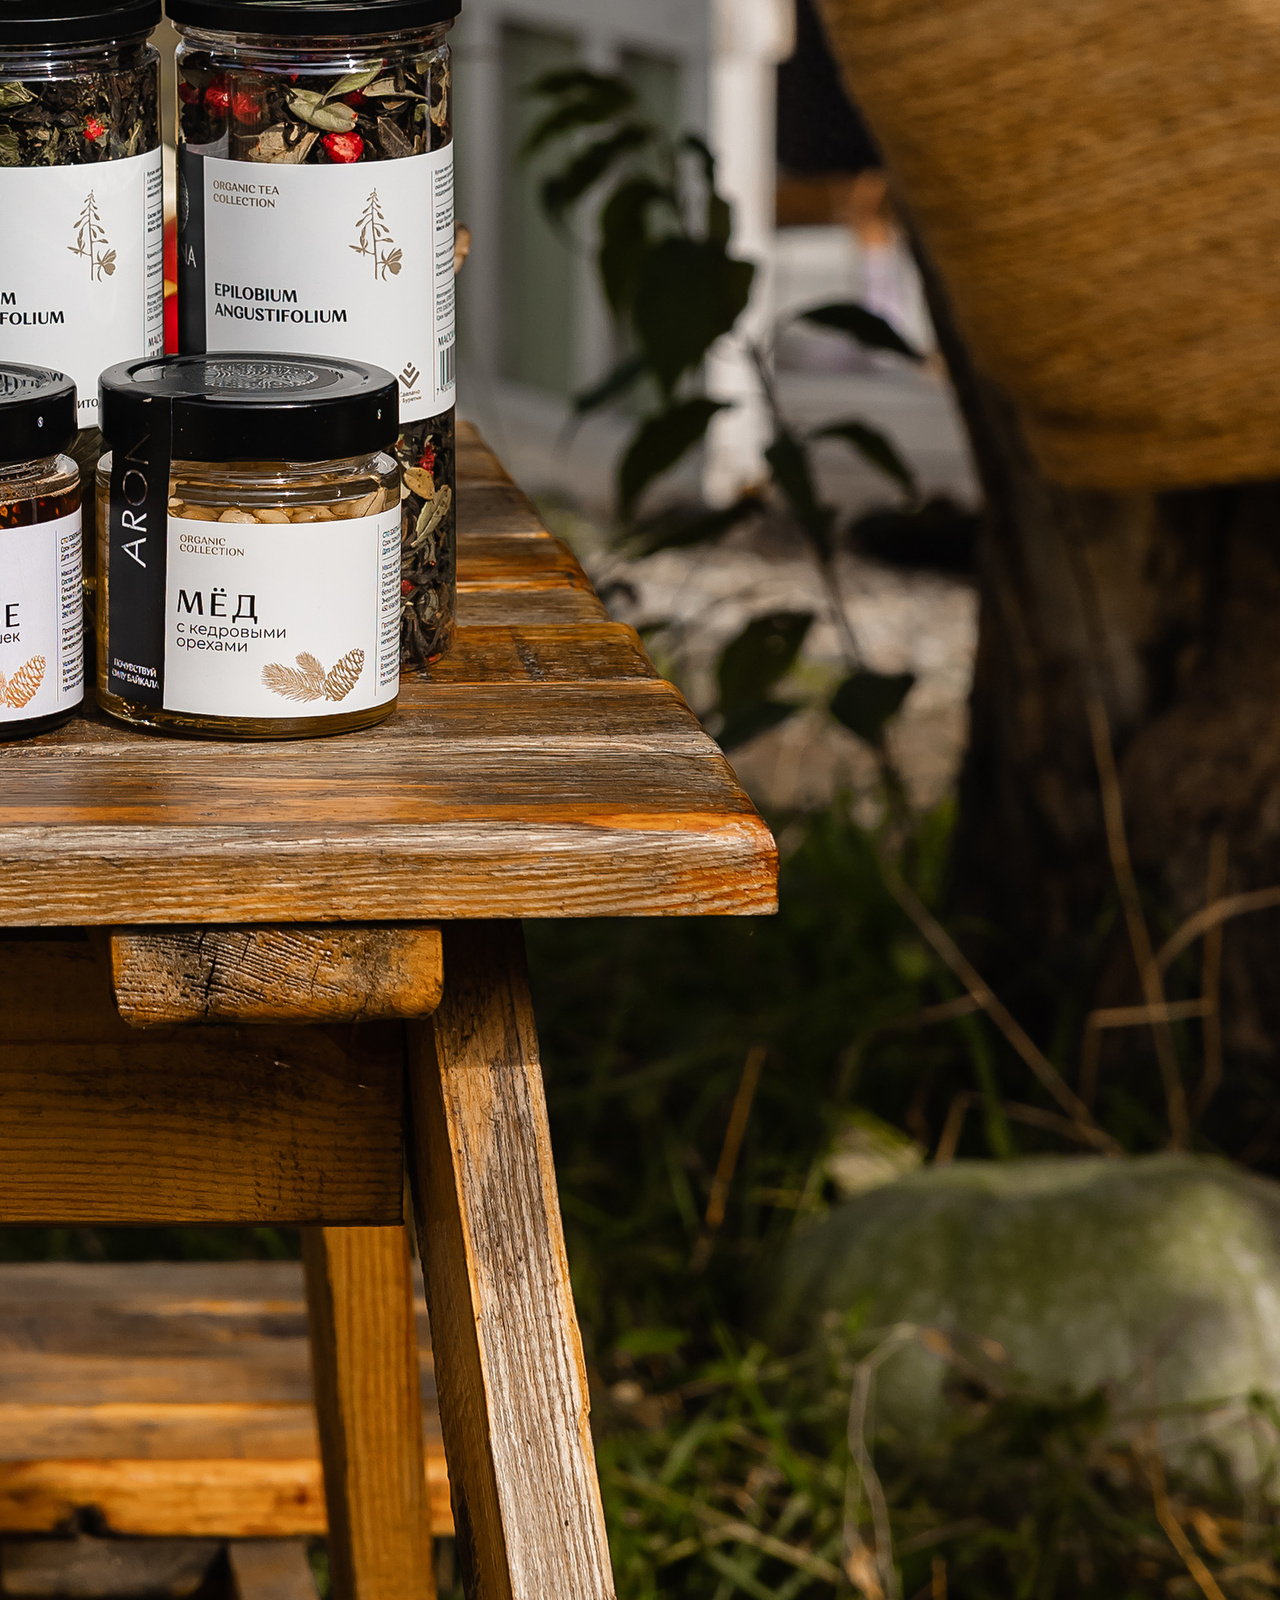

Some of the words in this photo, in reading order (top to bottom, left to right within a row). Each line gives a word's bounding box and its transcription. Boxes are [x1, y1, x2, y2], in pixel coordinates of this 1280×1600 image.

[213, 180, 255, 195] ORGANIC
[258, 185, 279, 195] TEA
[214, 192, 274, 207] COLLECTION
[214, 282, 298, 303] EPILOBIUM
[215, 302, 347, 323] ANGUSTIFOLIUM
[180, 534, 225, 547] ORGANIC
[180, 543, 244, 556] COLLECTION
[176, 587, 259, 624] МЁД
[177, 623, 184, 632] с
[191, 622, 285, 642] кедровыми
[177, 637, 247, 652] орехами
